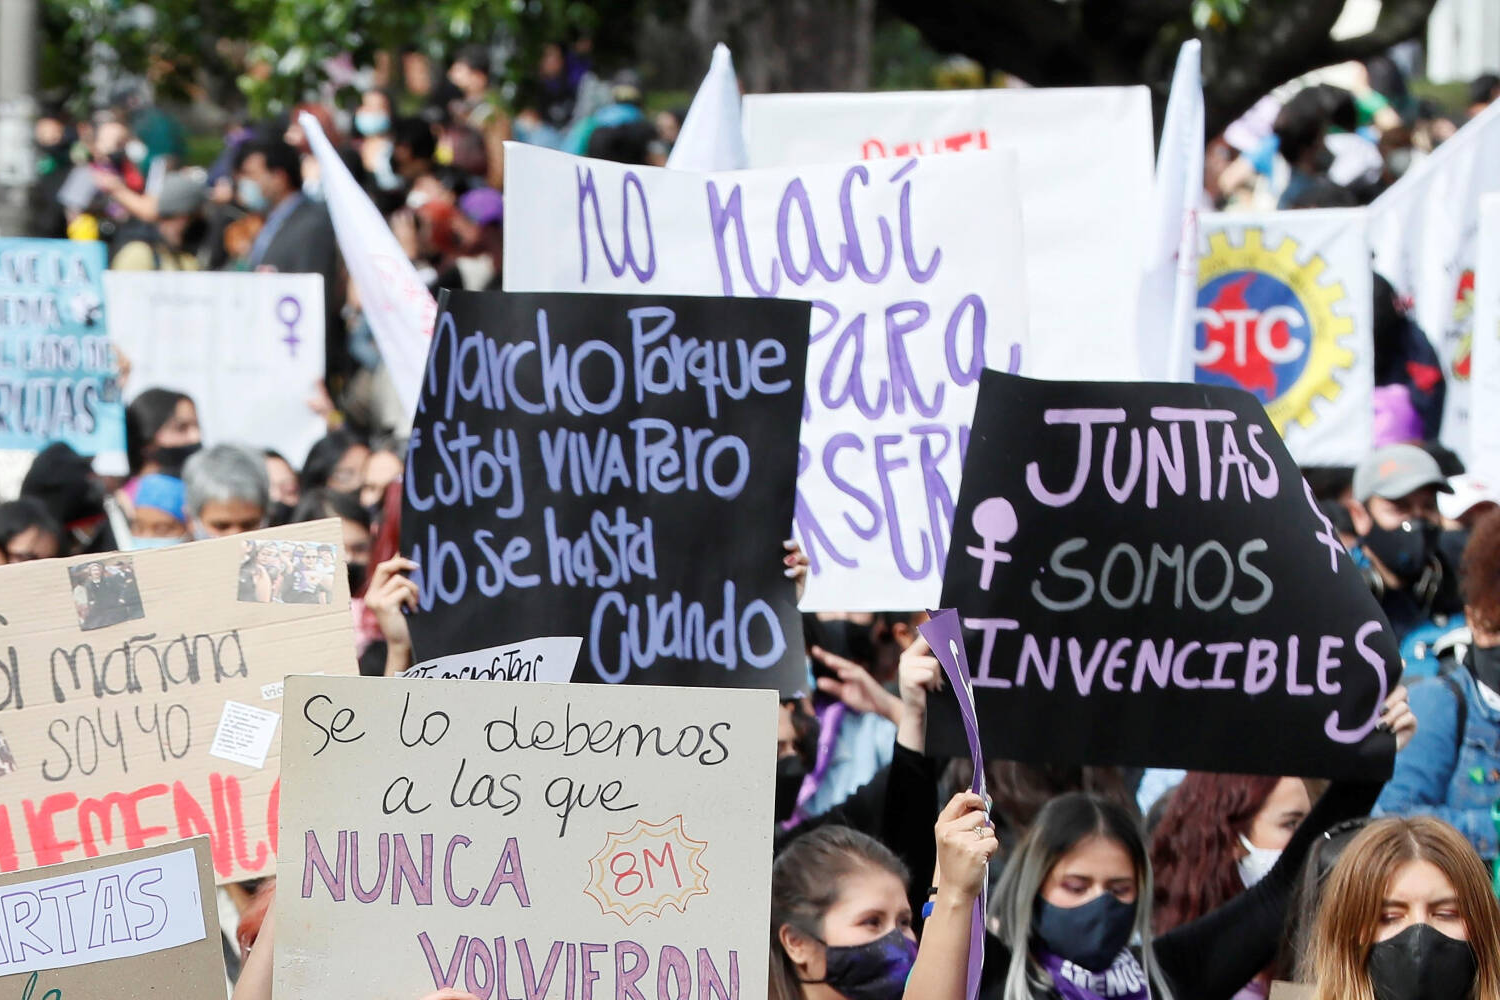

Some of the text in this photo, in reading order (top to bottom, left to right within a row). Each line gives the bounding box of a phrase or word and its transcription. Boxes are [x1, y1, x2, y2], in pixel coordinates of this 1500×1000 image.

[50, 254, 92, 284] LA
[1194, 305, 1306, 367] CTC
[1025, 406, 1280, 508] JUNTAS
[1031, 537, 1274, 614] SOMOS
[50, 629, 249, 703] mañana
[589, 578, 788, 684] Cuando
[962, 618, 1388, 744] INVENCIBLES
[303, 693, 366, 756] Se
[400, 692, 450, 748] lo
[483, 702, 732, 766] debemos
[382, 757, 639, 838] a las que
[301, 829, 683, 908] NUNCA 8M
